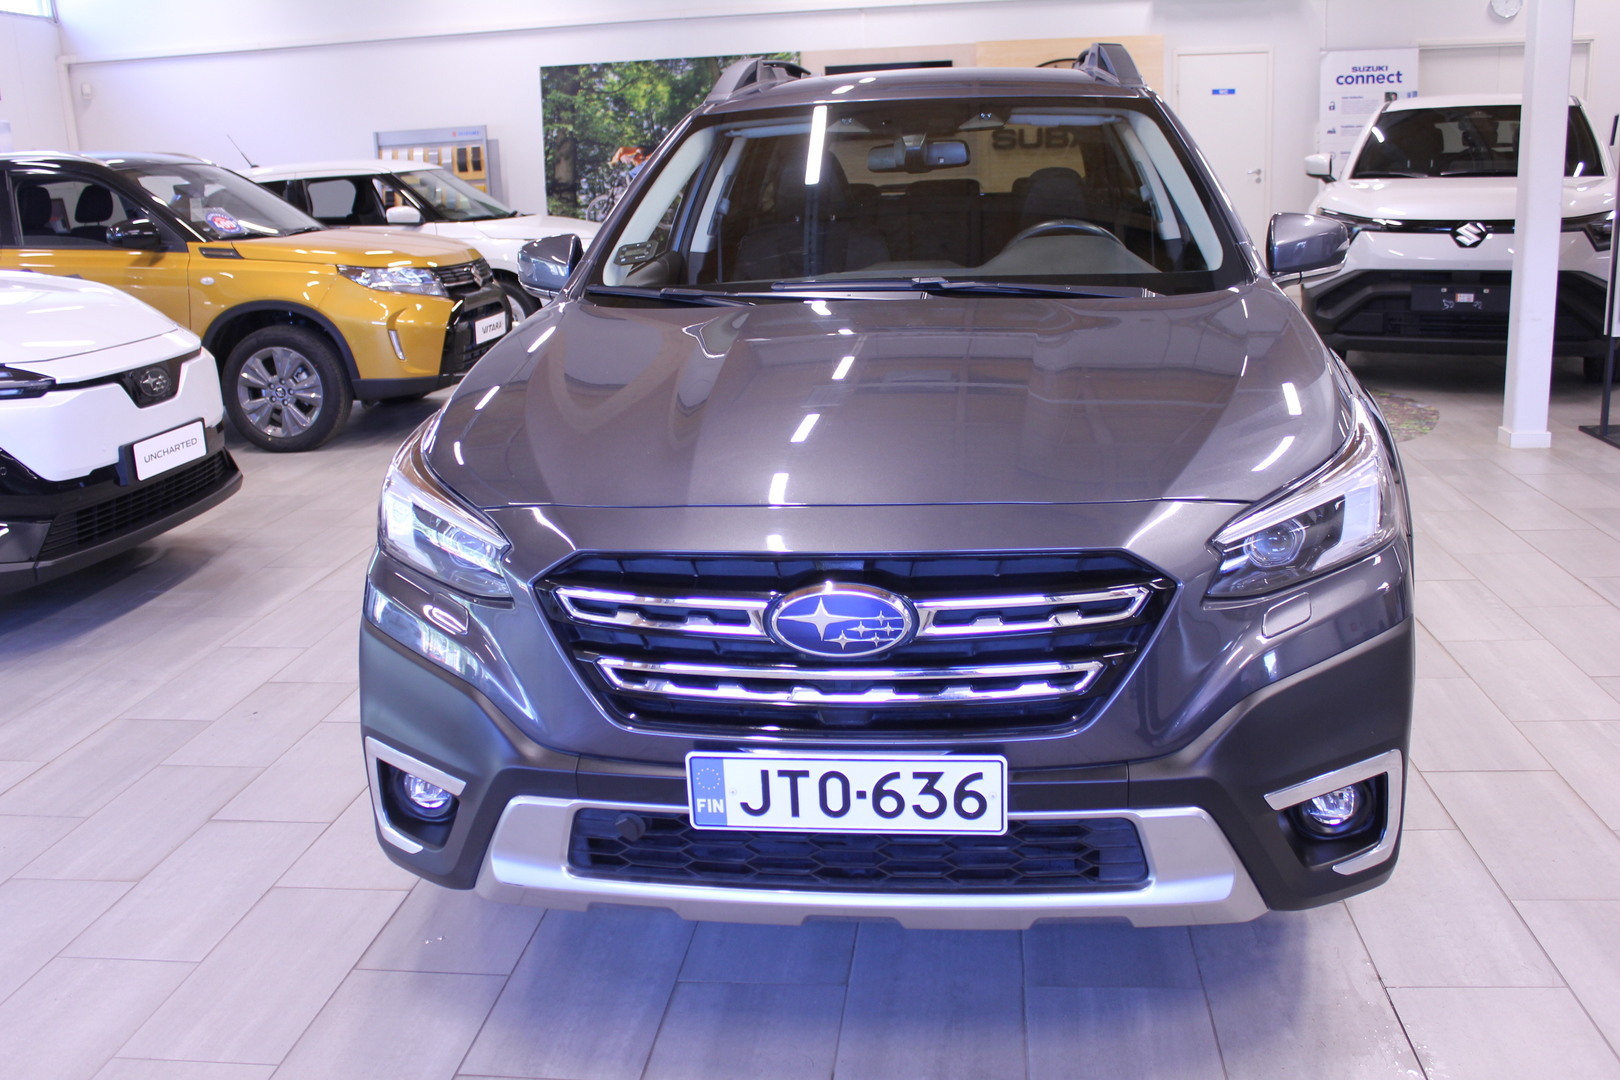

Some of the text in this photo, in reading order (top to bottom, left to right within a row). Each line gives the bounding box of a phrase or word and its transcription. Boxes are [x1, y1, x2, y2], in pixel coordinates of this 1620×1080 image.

[1336, 70, 1403, 85] connect
[1351, 65, 1389, 73] SUZUKI
[143, 437, 198, 463] UNCHARTED
[697, 769, 987, 820] FIN JTO-636
